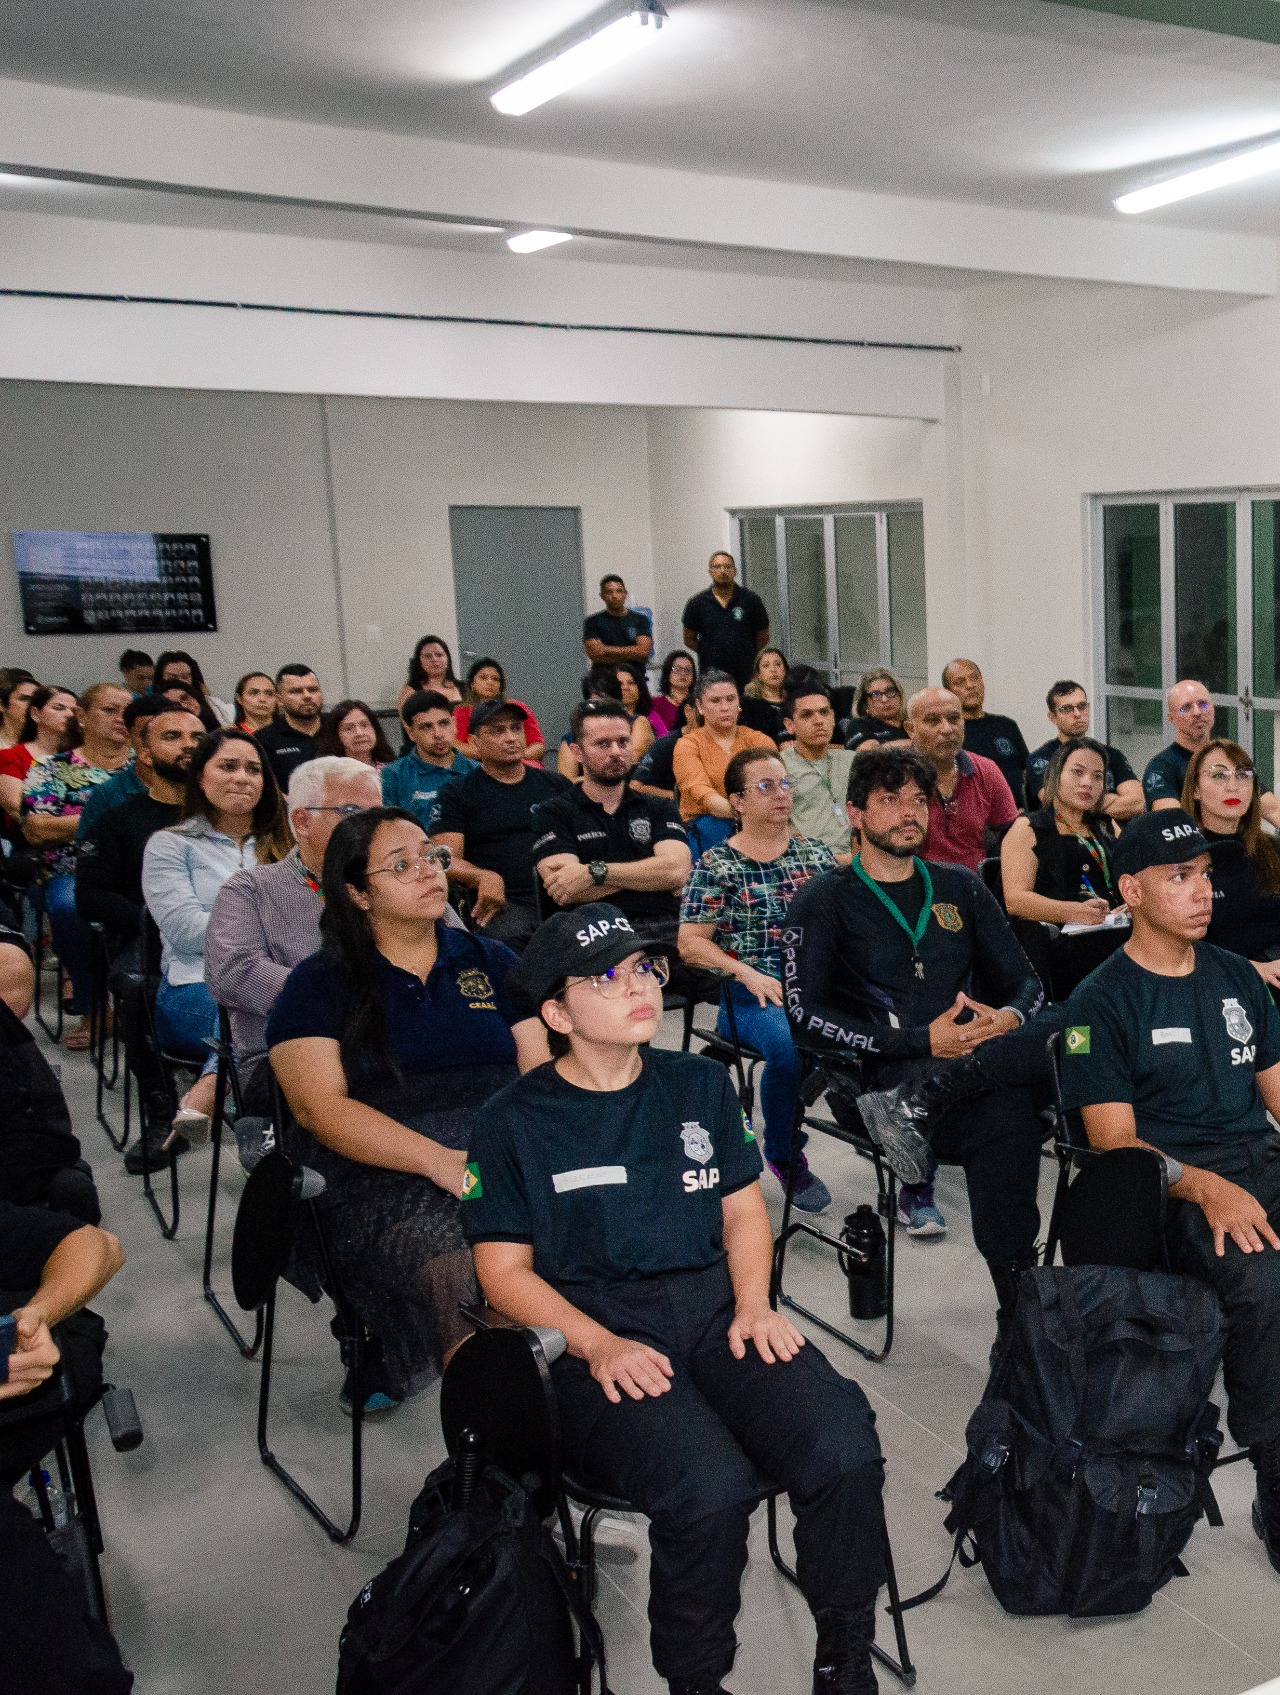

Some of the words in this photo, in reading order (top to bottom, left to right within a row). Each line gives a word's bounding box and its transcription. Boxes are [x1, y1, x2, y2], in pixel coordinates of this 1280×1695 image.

[807, 1015, 880, 1053] PENAL
[1230, 1045, 1257, 1066] SAP
[682, 1167, 720, 1193] SAP
